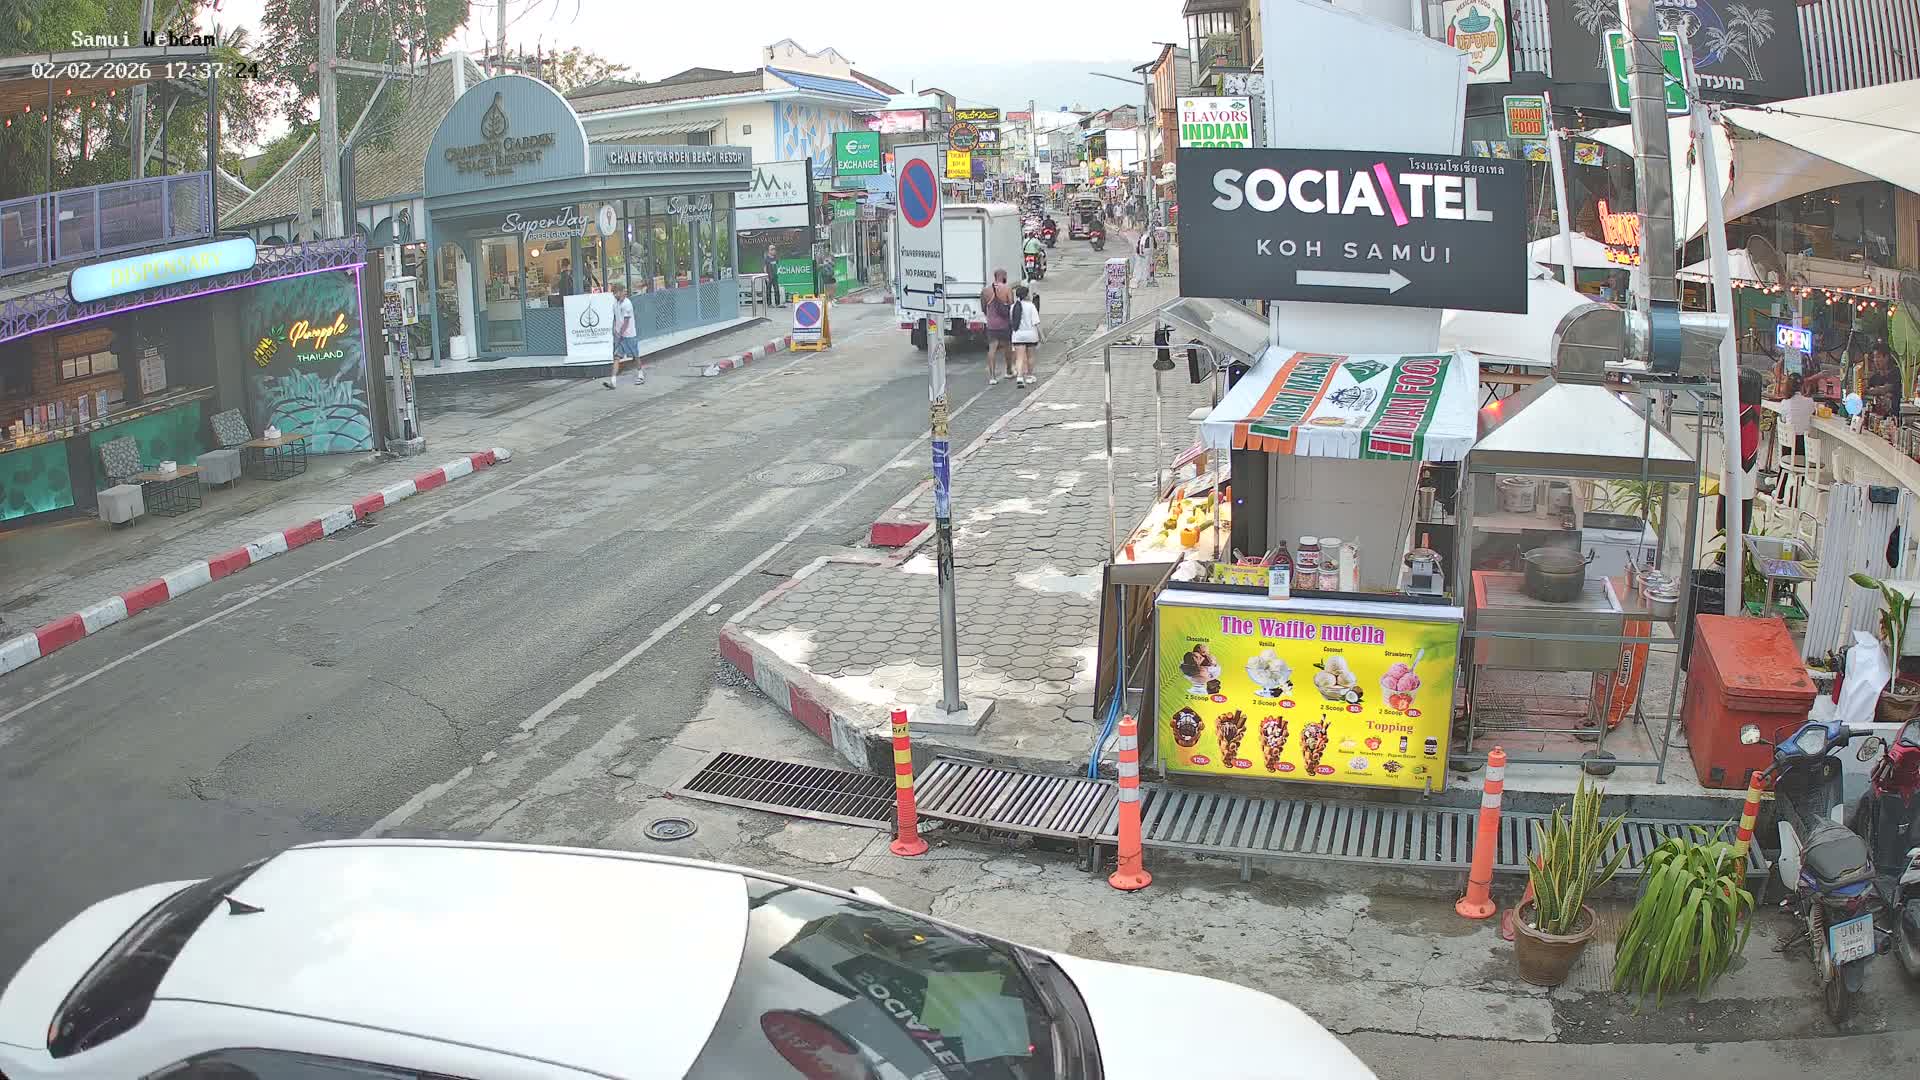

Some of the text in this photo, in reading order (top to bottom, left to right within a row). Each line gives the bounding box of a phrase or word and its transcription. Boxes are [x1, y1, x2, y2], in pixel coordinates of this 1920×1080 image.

[1184, 111, 1248, 122] FLAVORS
[1509, 109, 1541, 123] INDIAN
[1182, 123, 1248, 140] INDIAN
[1511, 121, 1541, 135] FOOD
[611, 152, 746, 164] CHAWENG GARDEN BEACH RESORT
[838, 159, 879, 169] EXCHANGE
[1409, 157, 1505, 176] โรงแรมโซเชียลเทล
[738, 190, 798, 200] CHAWENG
[1256, 239, 1451, 264] KOH SAMUI
[111, 251, 223, 288] DISPENSARY
[905, 269, 937, 279] NO PARKING
[1779, 328, 1810, 351] OPEN
[297, 350, 344, 362] THAILAND
[1300, 551, 1318, 560] nutella
[1220, 616, 1384, 645] The Waffle nutella
[1384, 651, 1412, 660] Strawberry
[1326, 705, 1344, 713] Scoop
[1367, 721, 1414, 735] Topping
